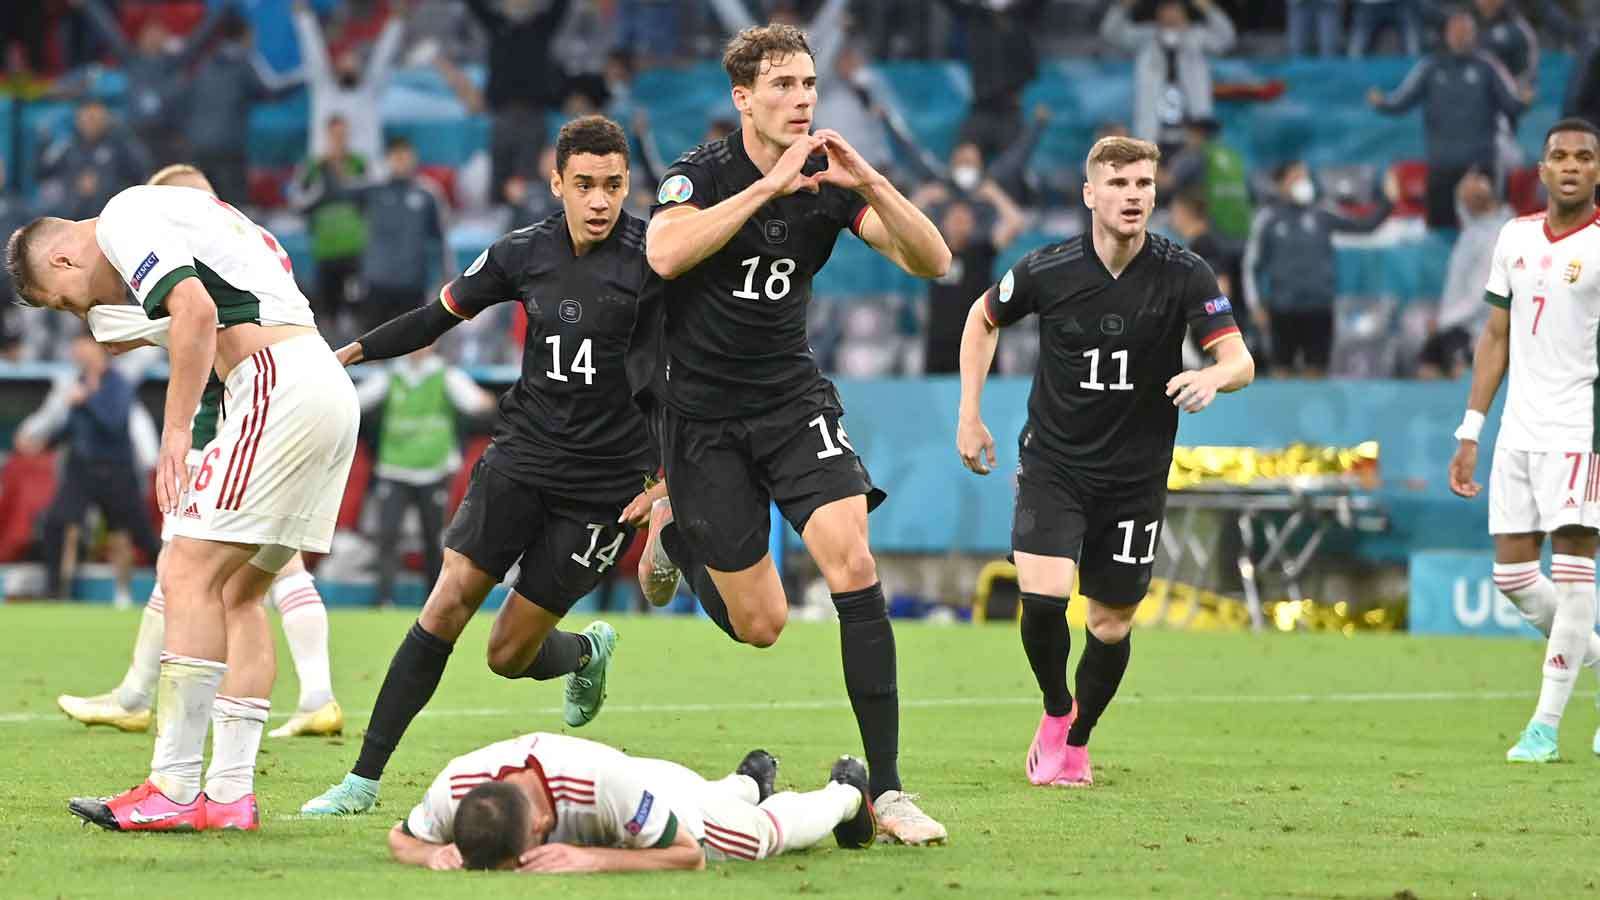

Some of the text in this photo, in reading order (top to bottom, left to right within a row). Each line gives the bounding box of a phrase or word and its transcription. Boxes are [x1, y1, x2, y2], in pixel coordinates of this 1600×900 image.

[732, 255, 796, 300] 18
[1532, 296, 1546, 336] 7
[545, 334, 597, 385] 14
[1080, 348, 1134, 391] 11
[194, 447, 221, 492] 6
[1565, 452, 1582, 490] 7
[571, 523, 625, 573] 14
[1112, 519, 1159, 565] 11
